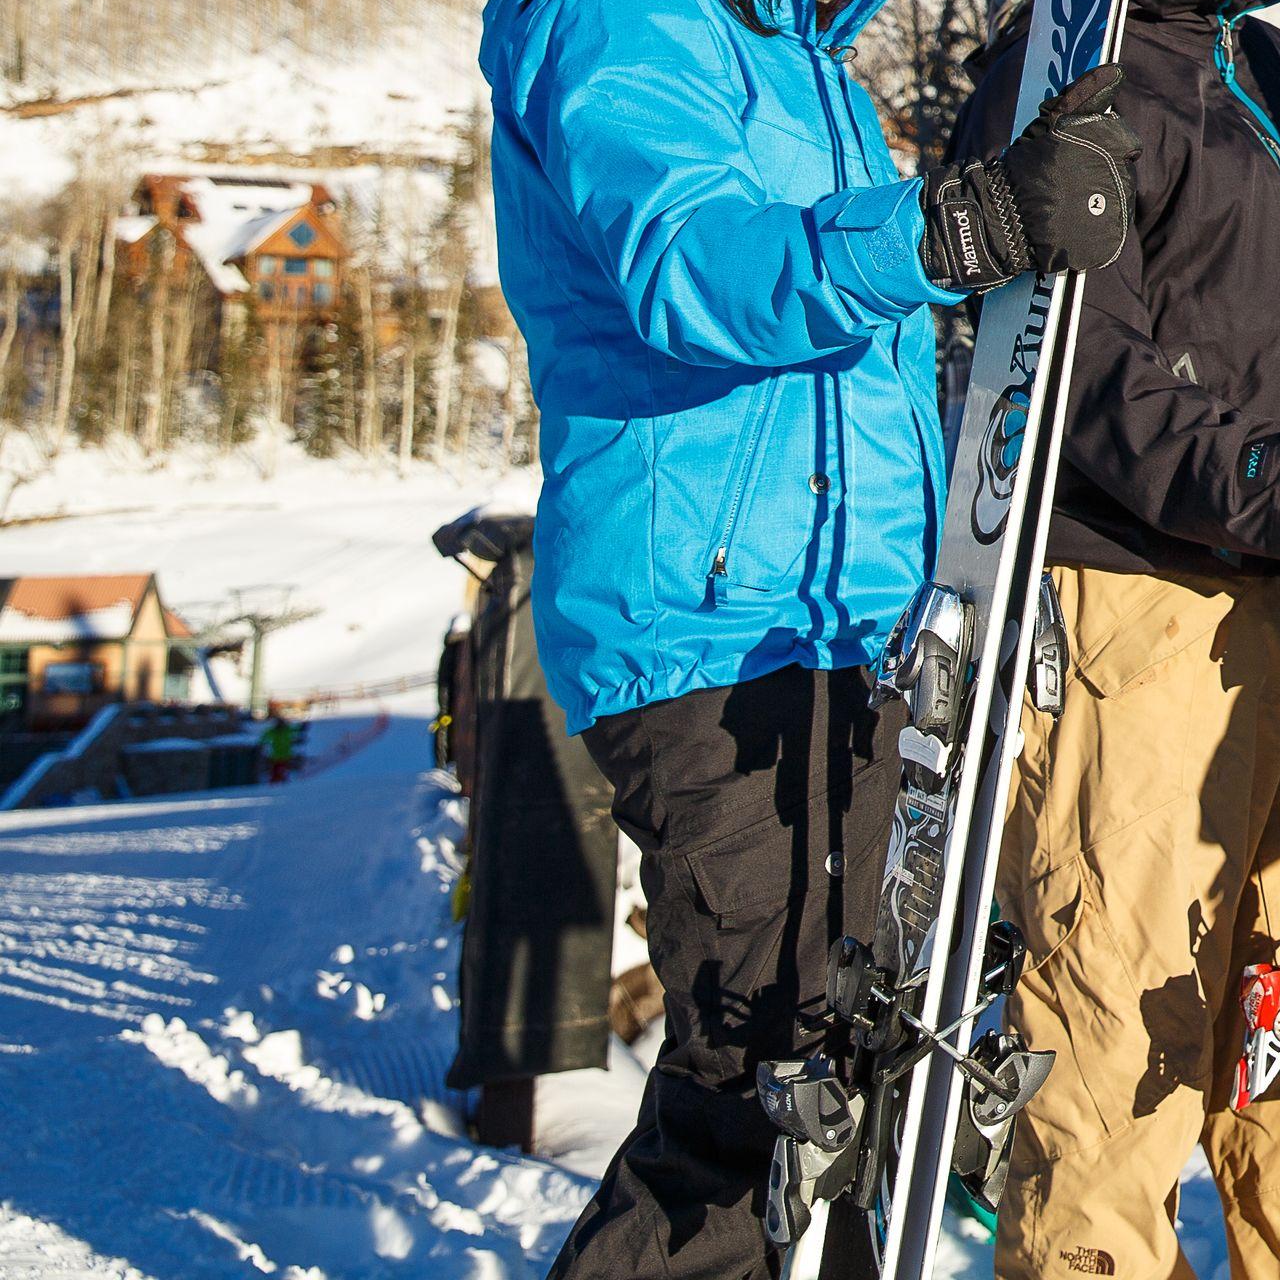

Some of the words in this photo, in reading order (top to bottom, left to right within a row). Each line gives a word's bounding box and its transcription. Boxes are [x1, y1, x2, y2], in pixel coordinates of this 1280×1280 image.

[952, 208, 981, 276] Marmot
[1059, 1250, 1097, 1266] NORTH
[1076, 1245, 1098, 1257] THE
[1068, 1260, 1095, 1274] FACE
